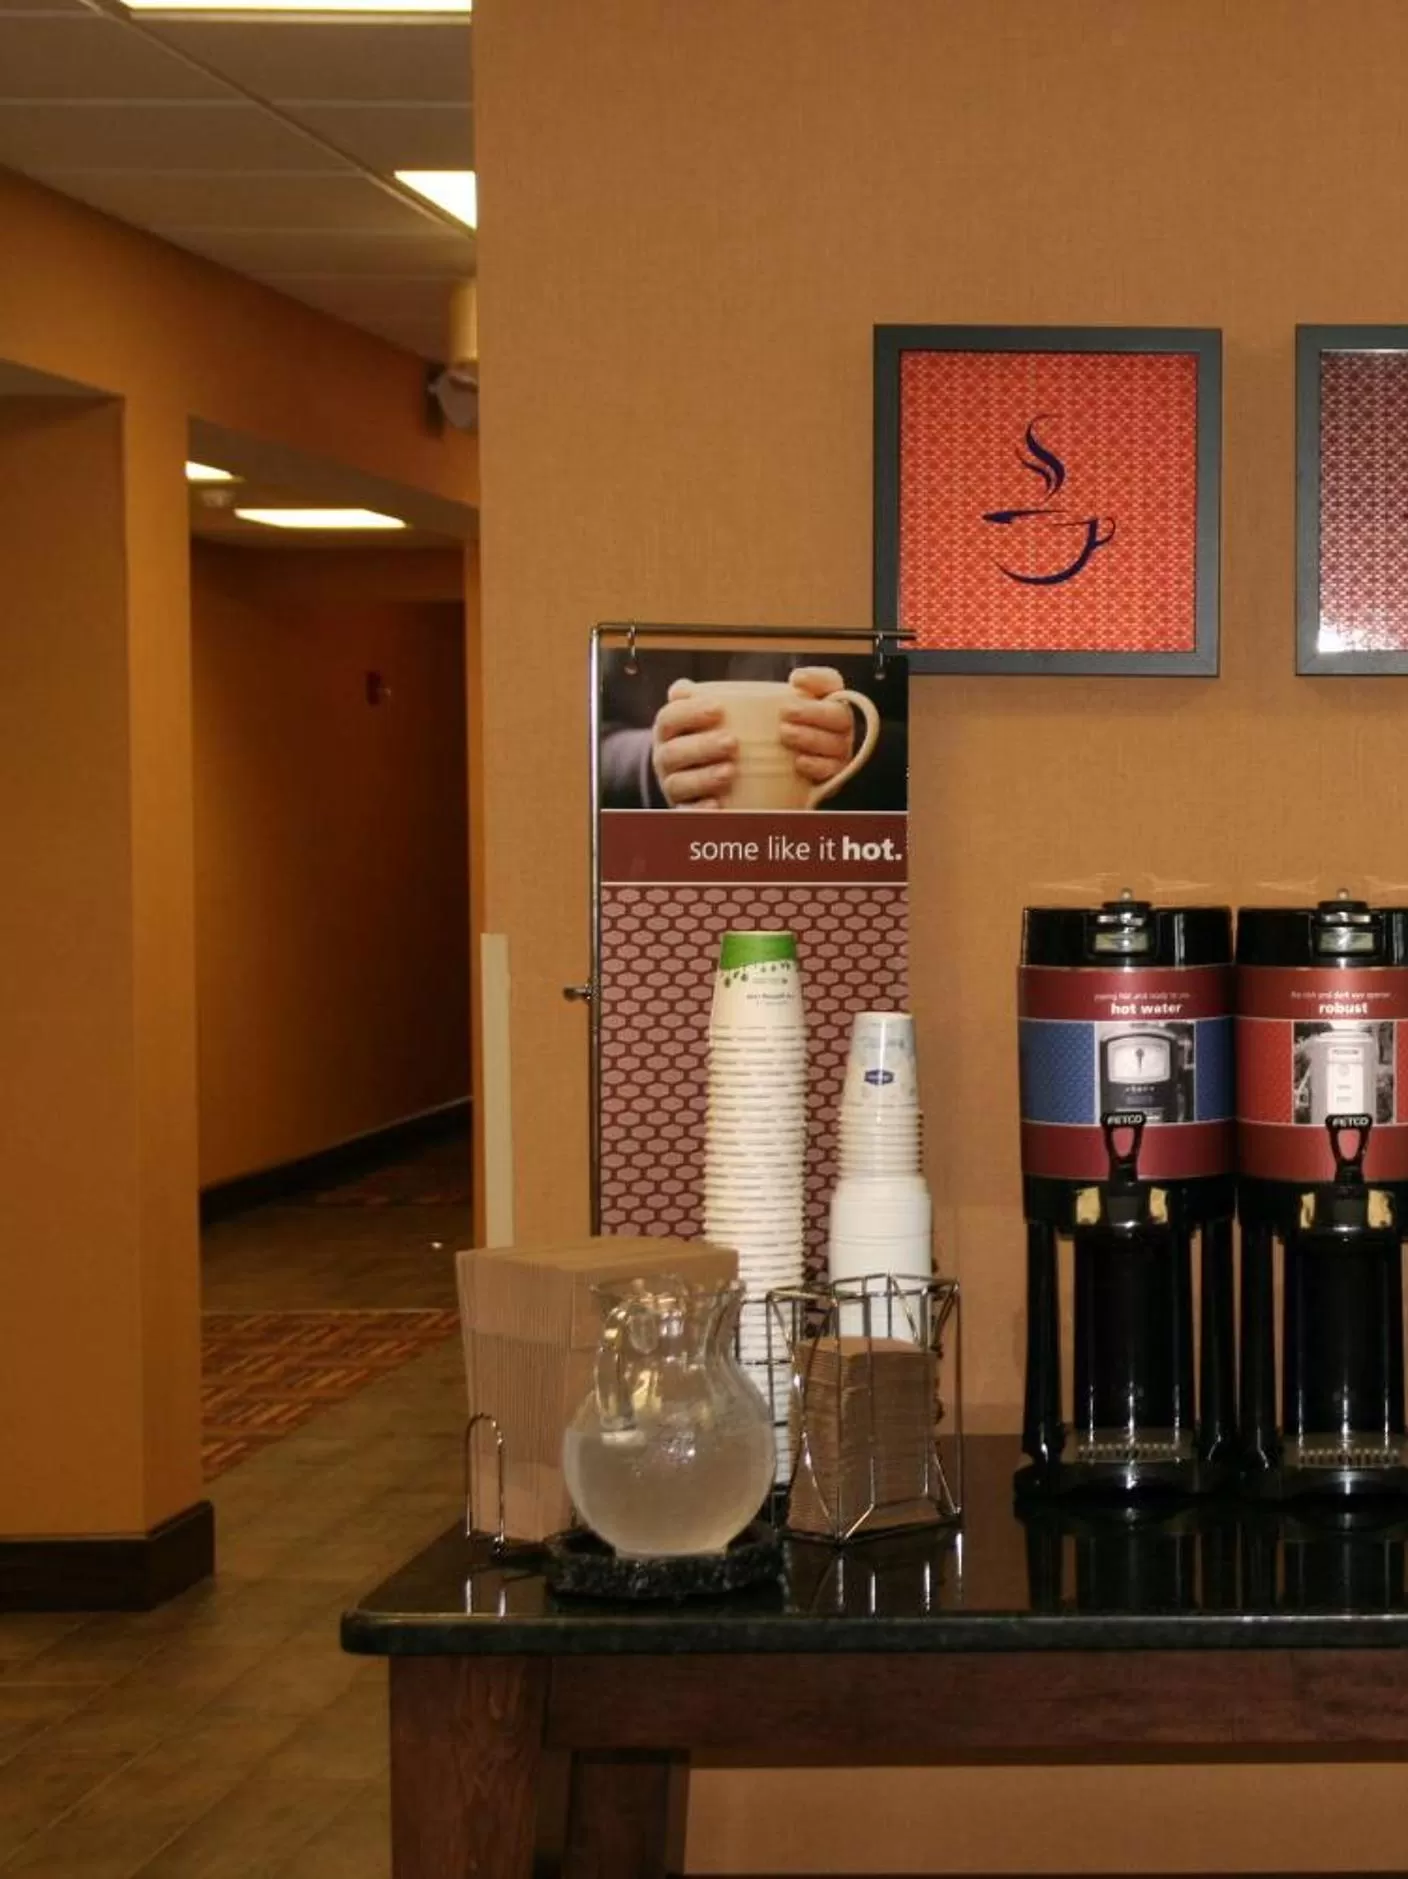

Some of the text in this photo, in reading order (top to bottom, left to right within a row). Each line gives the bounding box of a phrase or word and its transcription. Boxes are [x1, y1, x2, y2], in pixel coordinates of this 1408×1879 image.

[690, 835, 903, 861] some like it hot.
[1111, 1003, 1182, 1015] hot water
[1319, 1002, 1367, 1014] robust
